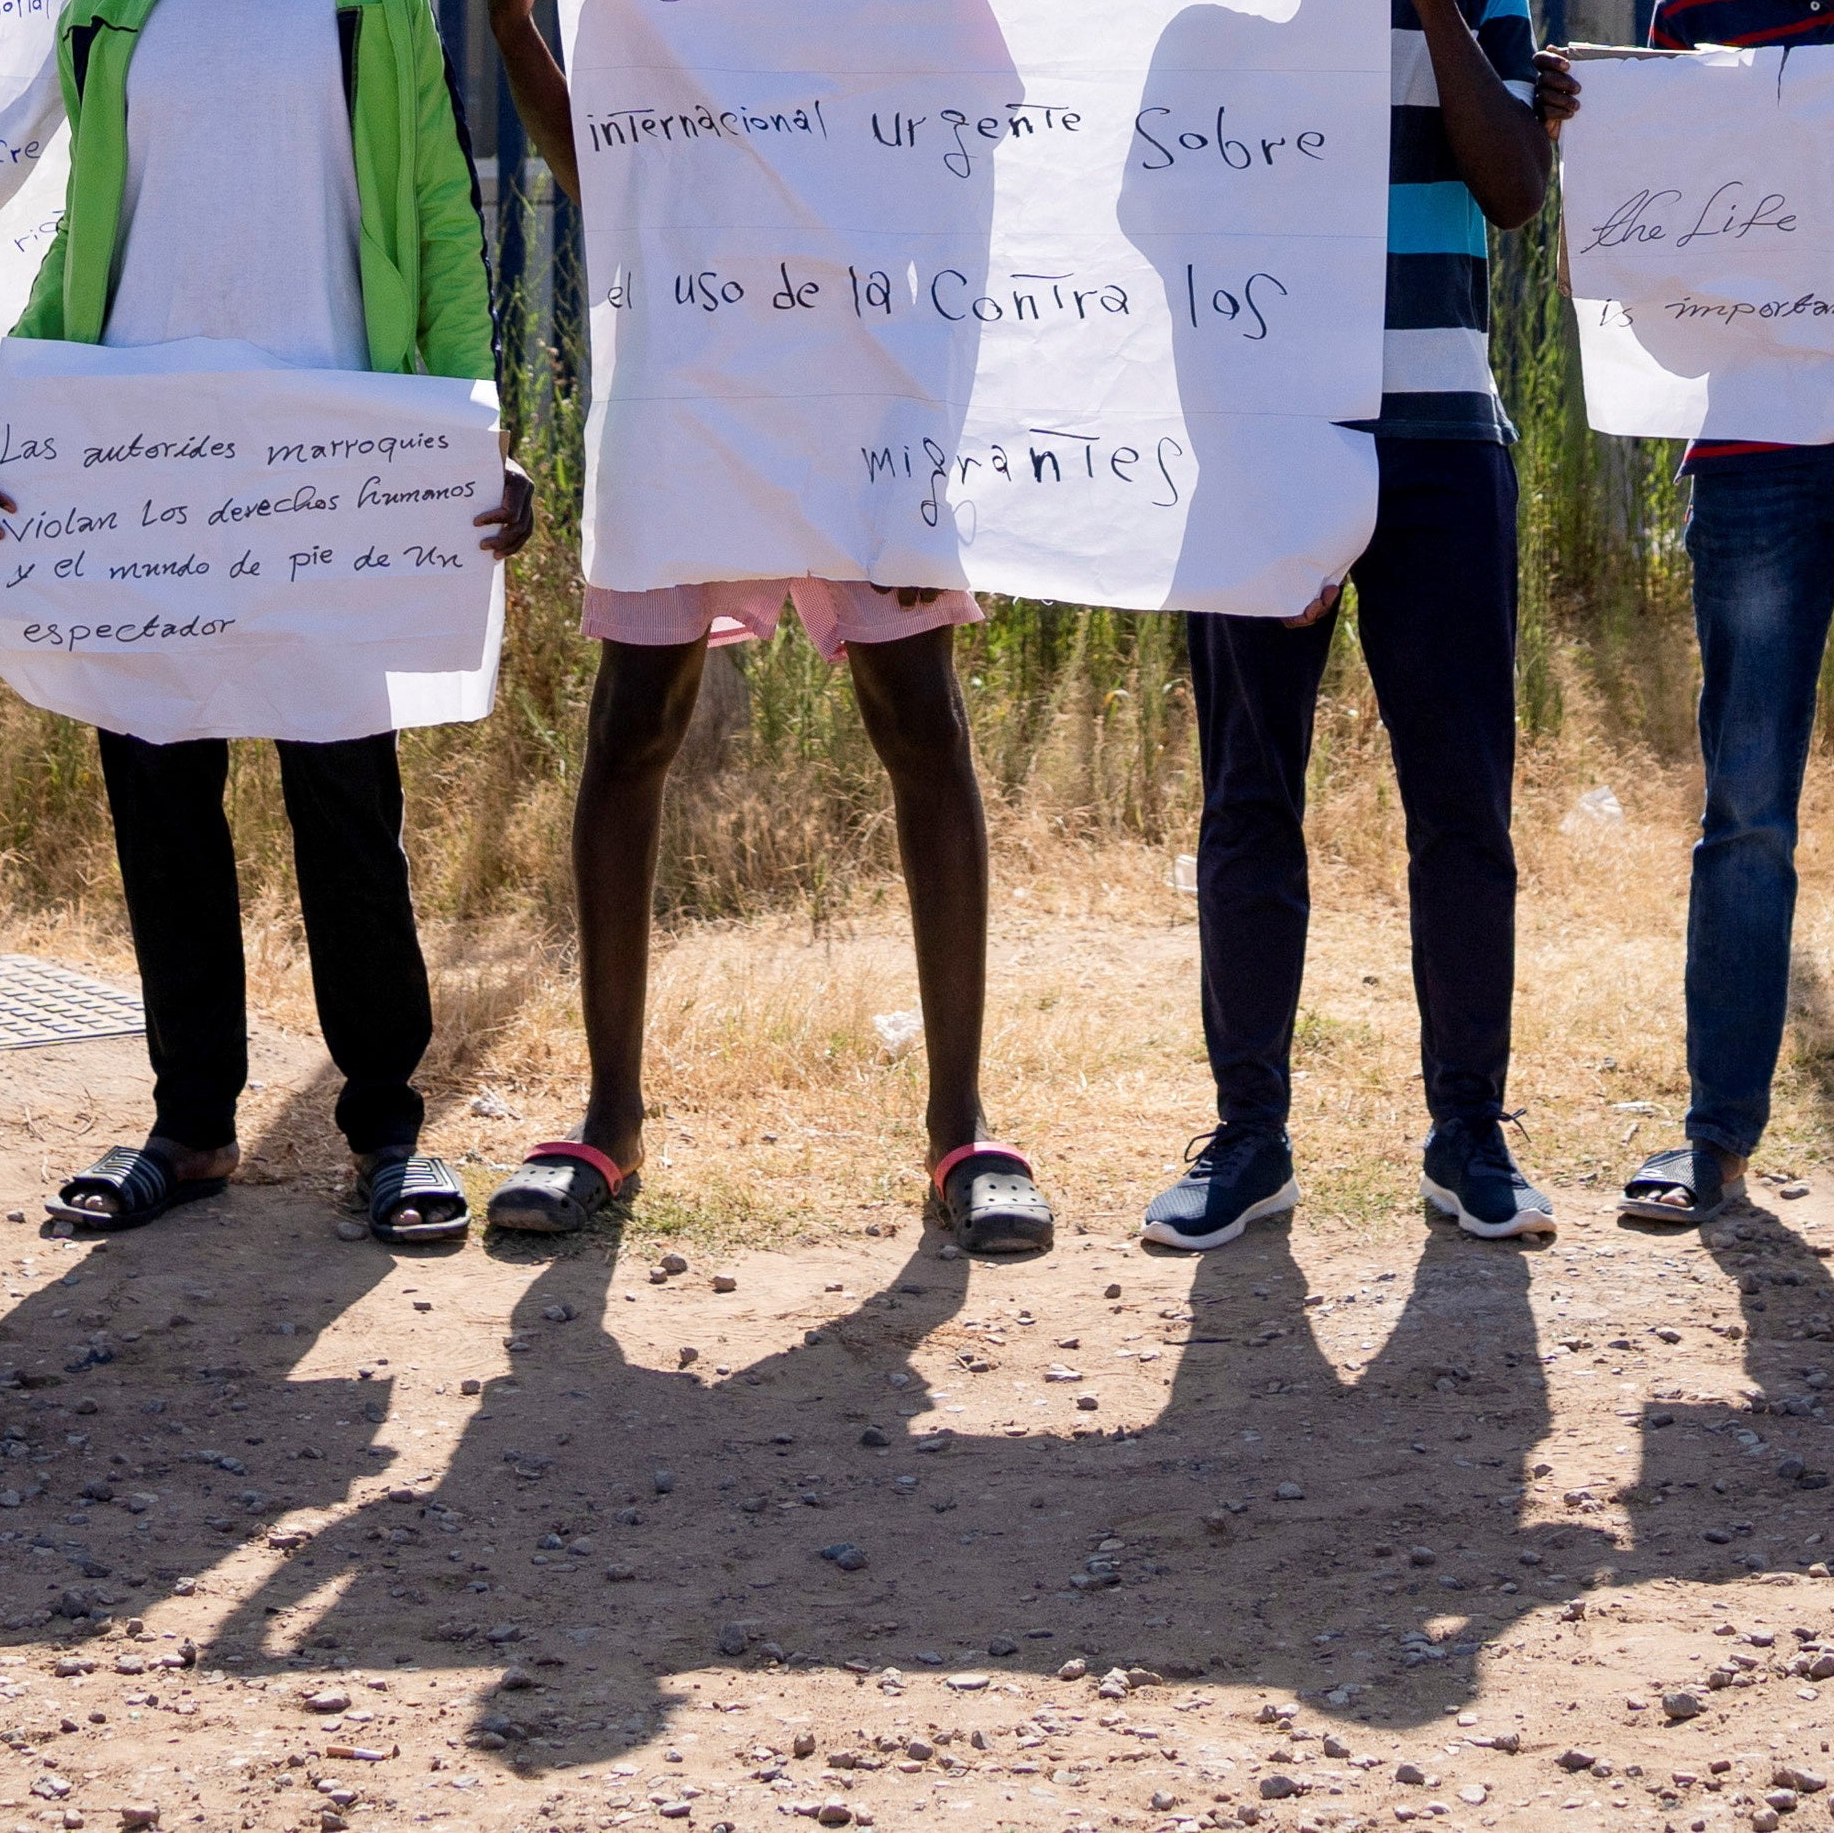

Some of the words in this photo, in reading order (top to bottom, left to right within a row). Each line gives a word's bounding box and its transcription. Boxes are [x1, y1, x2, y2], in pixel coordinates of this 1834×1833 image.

[607, 270, 632, 311] el
[673, 270, 745, 312] uso
[771, 262, 820, 311] de
[848, 263, 894, 317] la
[1598, 298, 1633, 328] is
[0, 424, 58, 465] Las
[5, 562, 36, 588] y
[53, 550, 85, 578] el
[229, 550, 261, 578] de
[289, 545, 333, 582] pie
[353, 543, 391, 570] de
[23, 614, 235, 652] espectador
